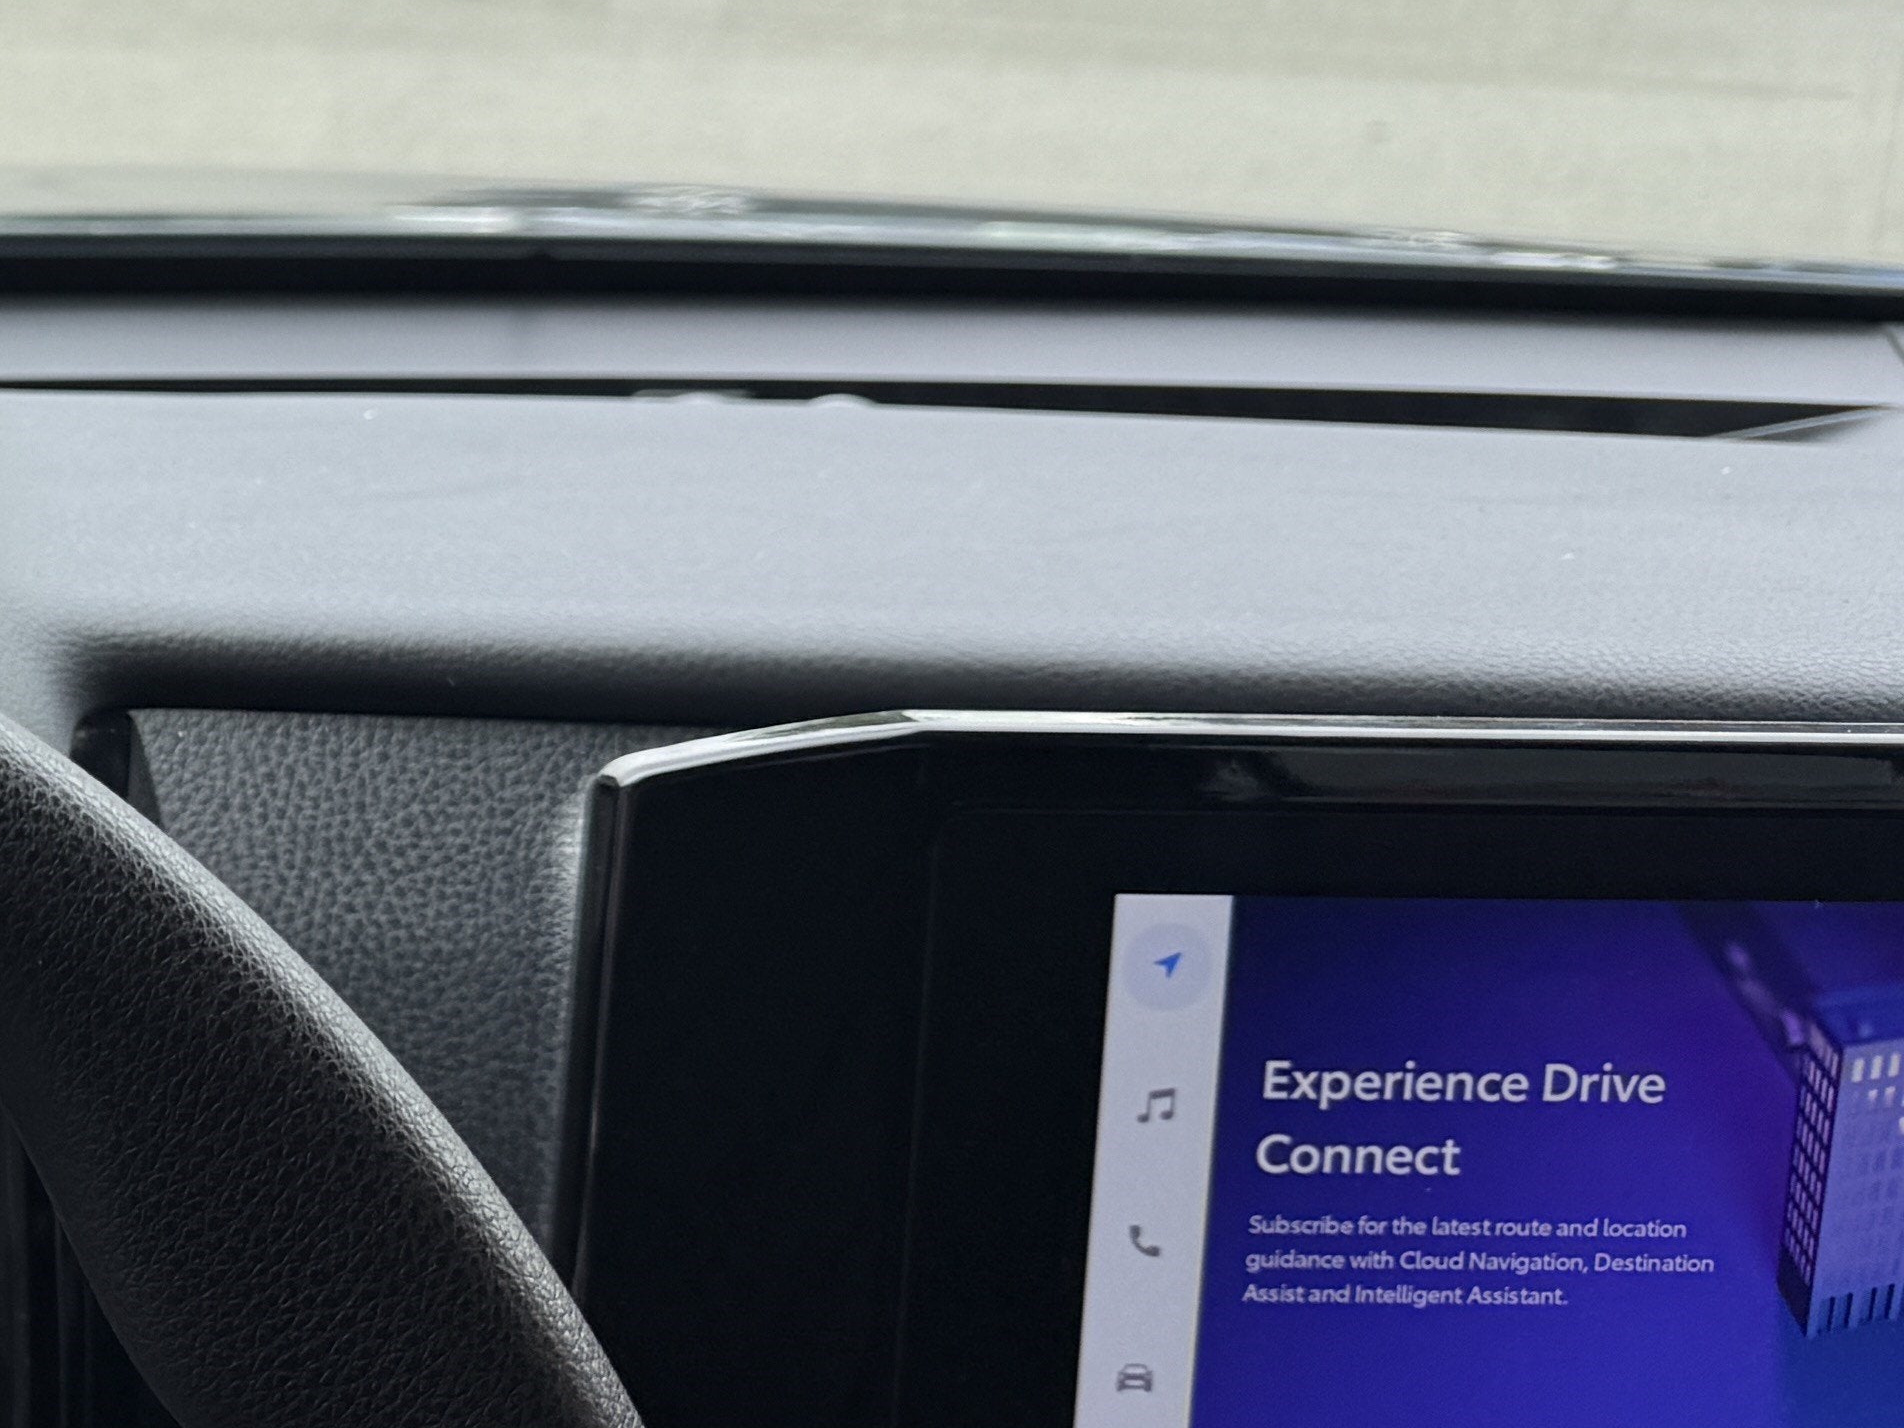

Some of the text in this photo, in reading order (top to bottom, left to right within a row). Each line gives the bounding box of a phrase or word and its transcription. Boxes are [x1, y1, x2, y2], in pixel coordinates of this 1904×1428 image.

[1262, 1059, 1667, 1110] Experience Drive
[1255, 1133, 1462, 1176] Connect
[1248, 1214, 1687, 1238] Subscribe for the latest route and location
[1245, 1249, 1715, 1275] guidance with Cloud Navigation, Destination
[1242, 1283, 1569, 1309] Assist and Intelligent Assistant.
